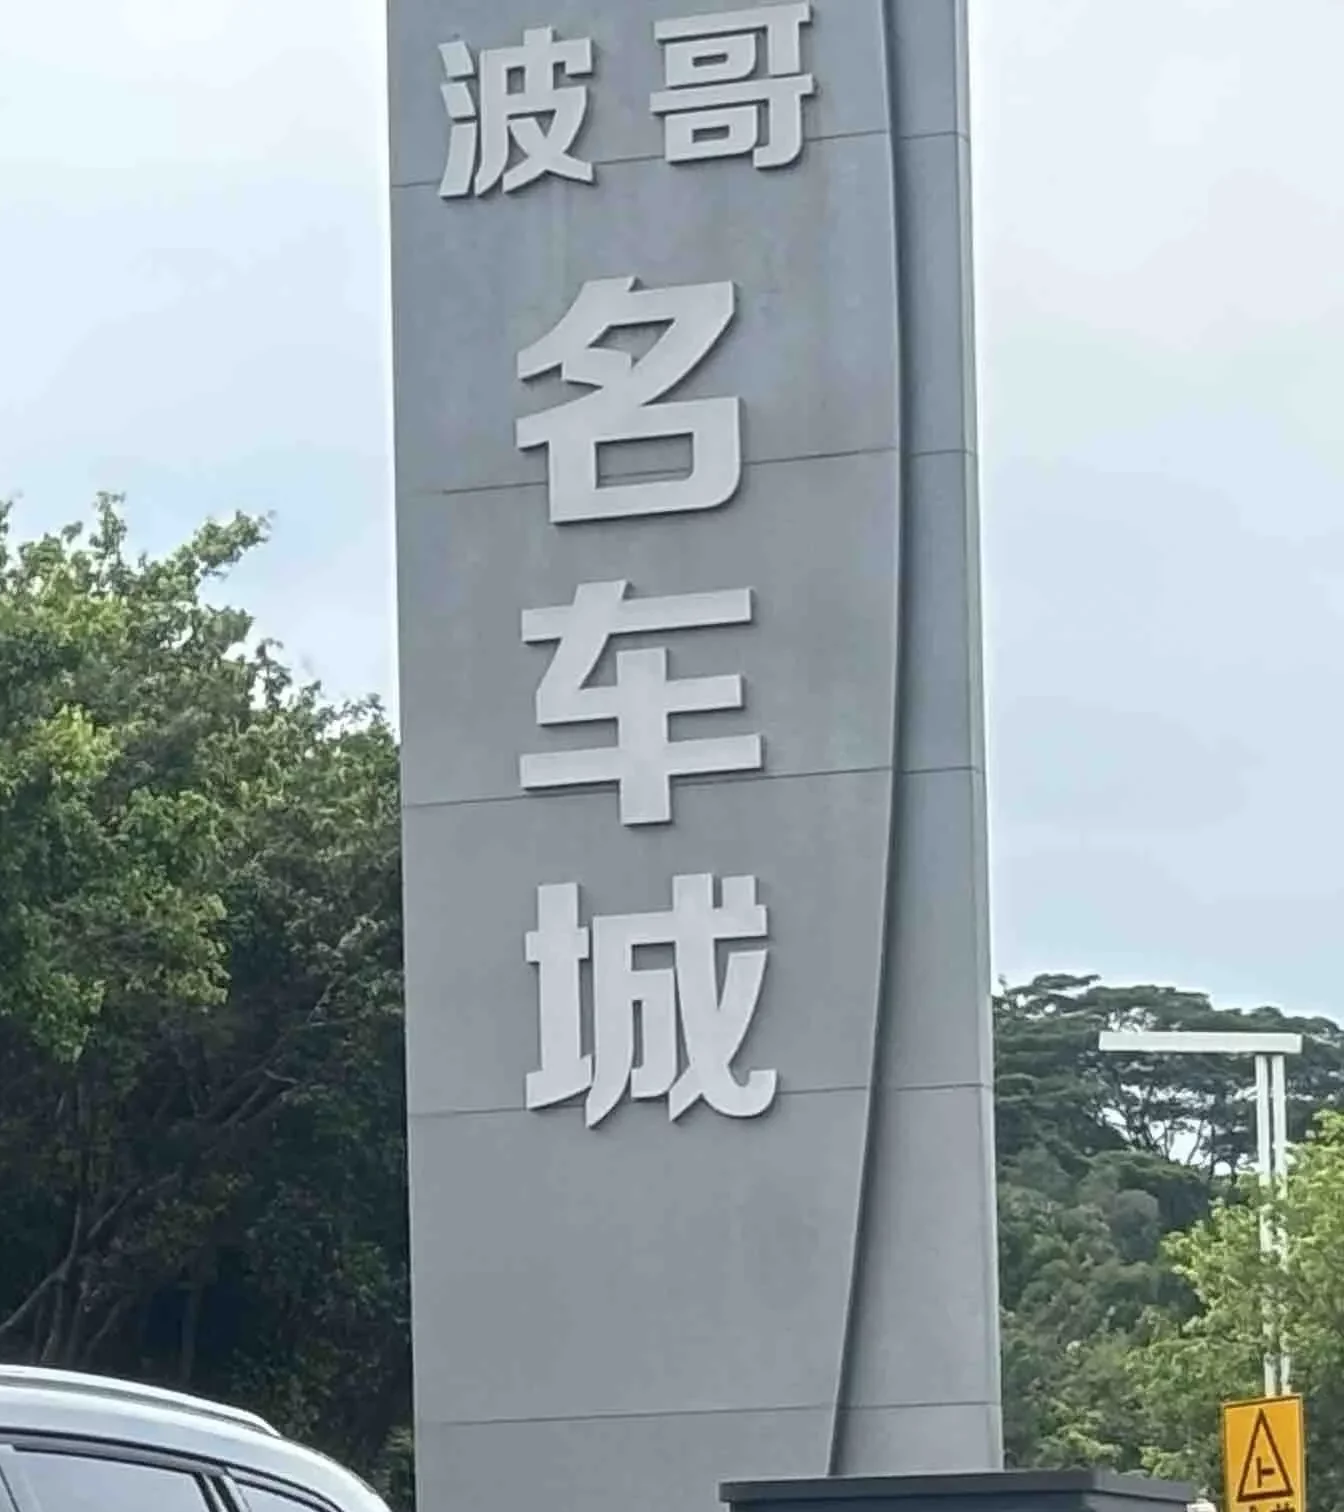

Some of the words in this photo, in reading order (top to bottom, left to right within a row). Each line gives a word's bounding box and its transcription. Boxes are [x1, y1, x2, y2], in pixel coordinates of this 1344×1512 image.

[437, 2, 816, 198] 波哥
[515, 275, 778, 1129] 名车城
